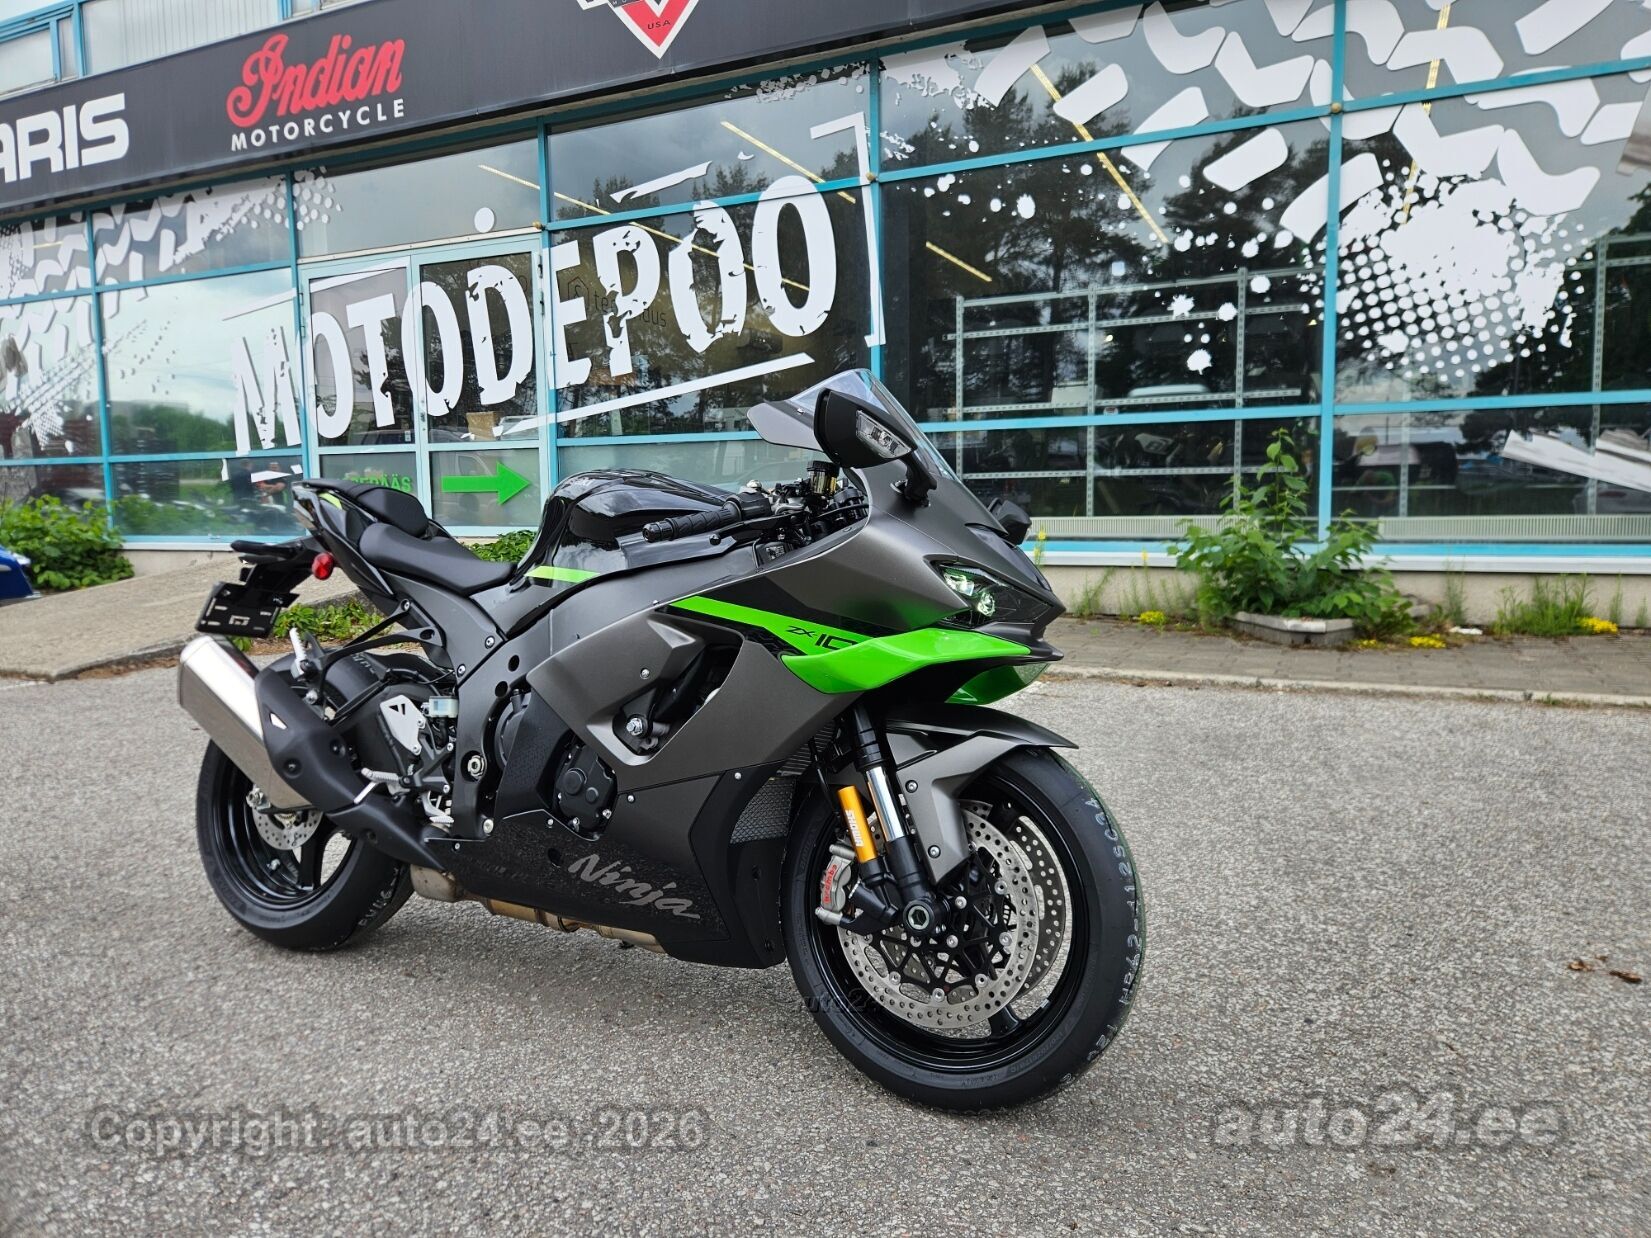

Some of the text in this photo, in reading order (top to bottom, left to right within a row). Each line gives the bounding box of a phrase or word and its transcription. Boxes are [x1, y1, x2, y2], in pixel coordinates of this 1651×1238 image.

[647, 19, 671, 30] USA
[226, 33, 407, 128] Indian
[230, 98, 405, 152] MOTORCYCLE
[230, 175, 838, 456] MOTODEPOO
[567, 853, 701, 920] Ninja
